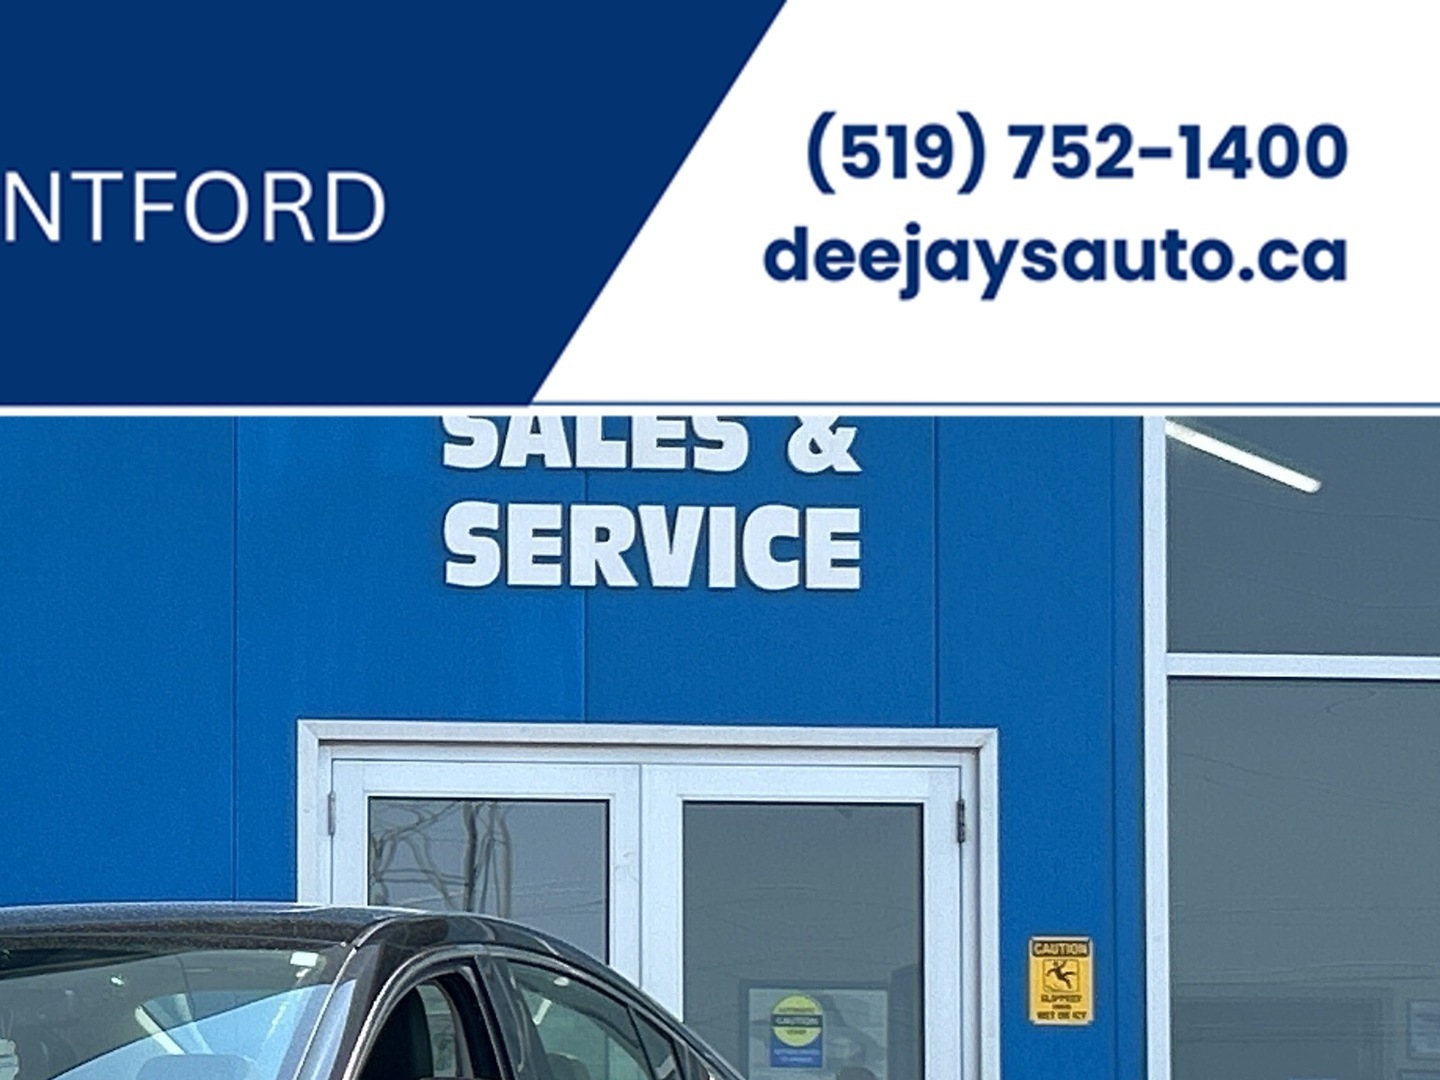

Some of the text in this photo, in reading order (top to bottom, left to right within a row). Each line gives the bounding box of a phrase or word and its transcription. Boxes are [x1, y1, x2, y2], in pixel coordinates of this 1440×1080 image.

[442, 416, 863, 473] SALES &
[444, 500, 861, 590] SERVICE
[1034, 943, 1087, 955] CAUTION
